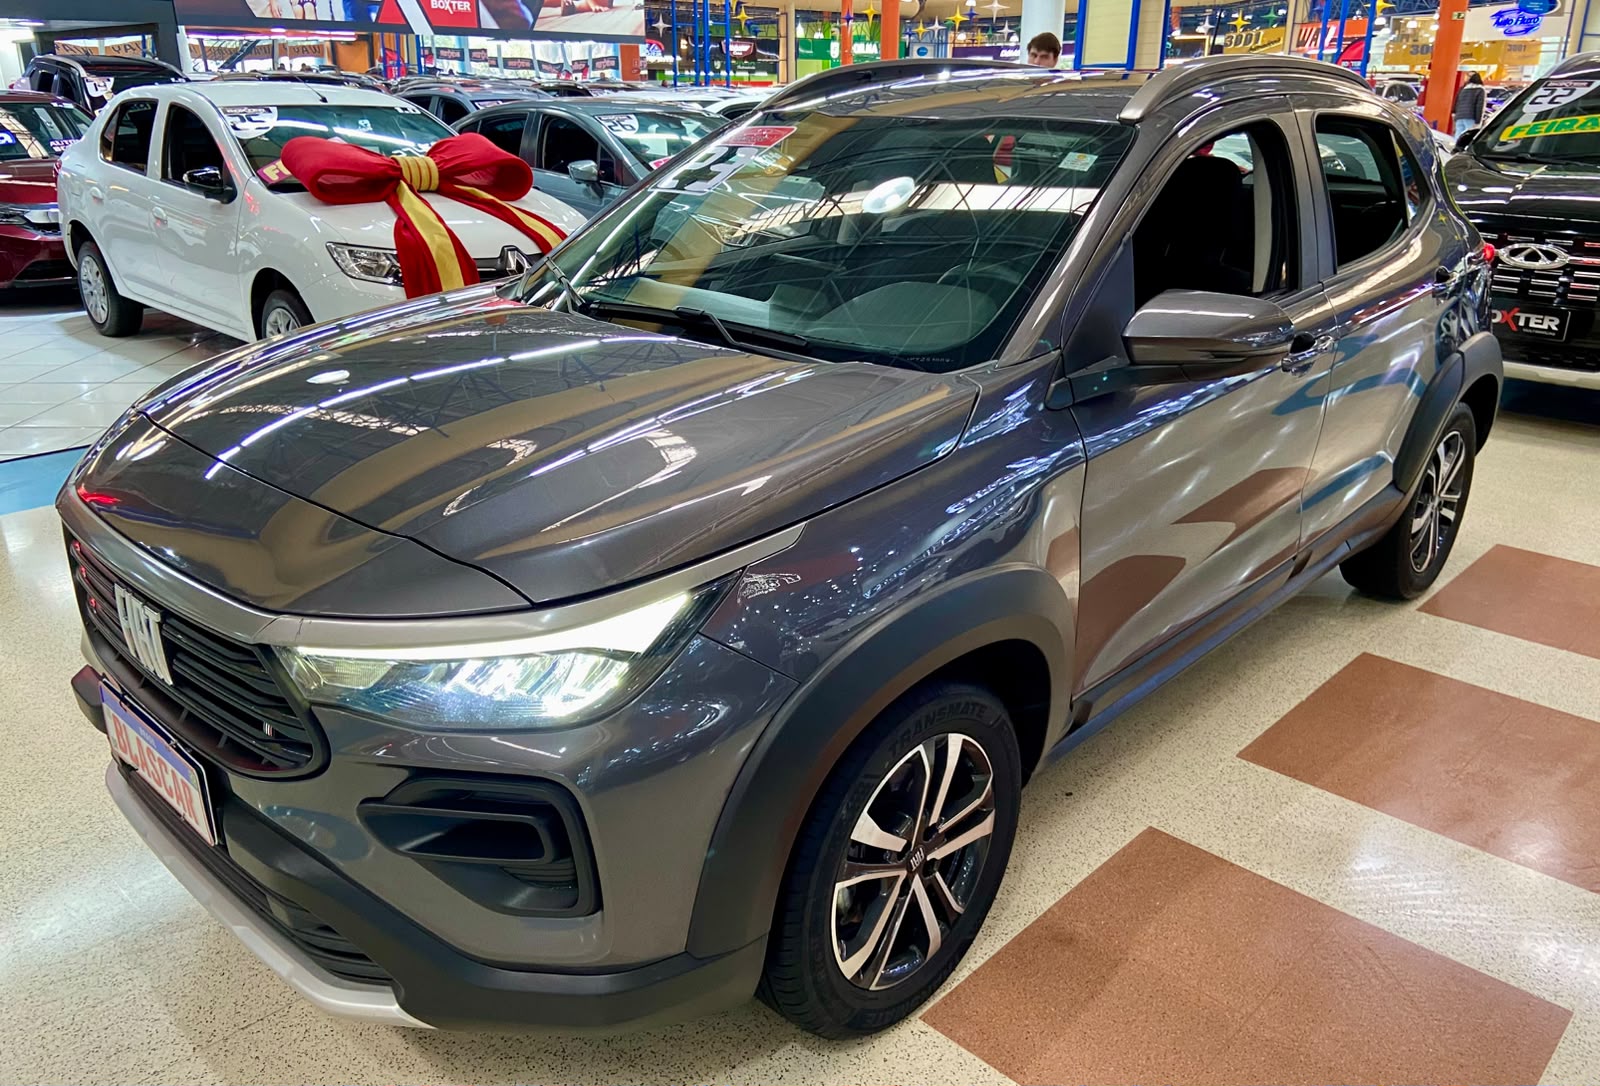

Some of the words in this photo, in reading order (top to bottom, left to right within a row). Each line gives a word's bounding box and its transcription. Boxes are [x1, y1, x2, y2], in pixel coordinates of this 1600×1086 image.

[430, 0, 472, 15] BOXTER
[1529, 88, 1576, 105] 22
[607, 119, 636, 131] 26
[114, 583, 174, 686] FIAT
[111, 714, 200, 827] BLASCAR
[910, 847, 925, 871] FIAT
